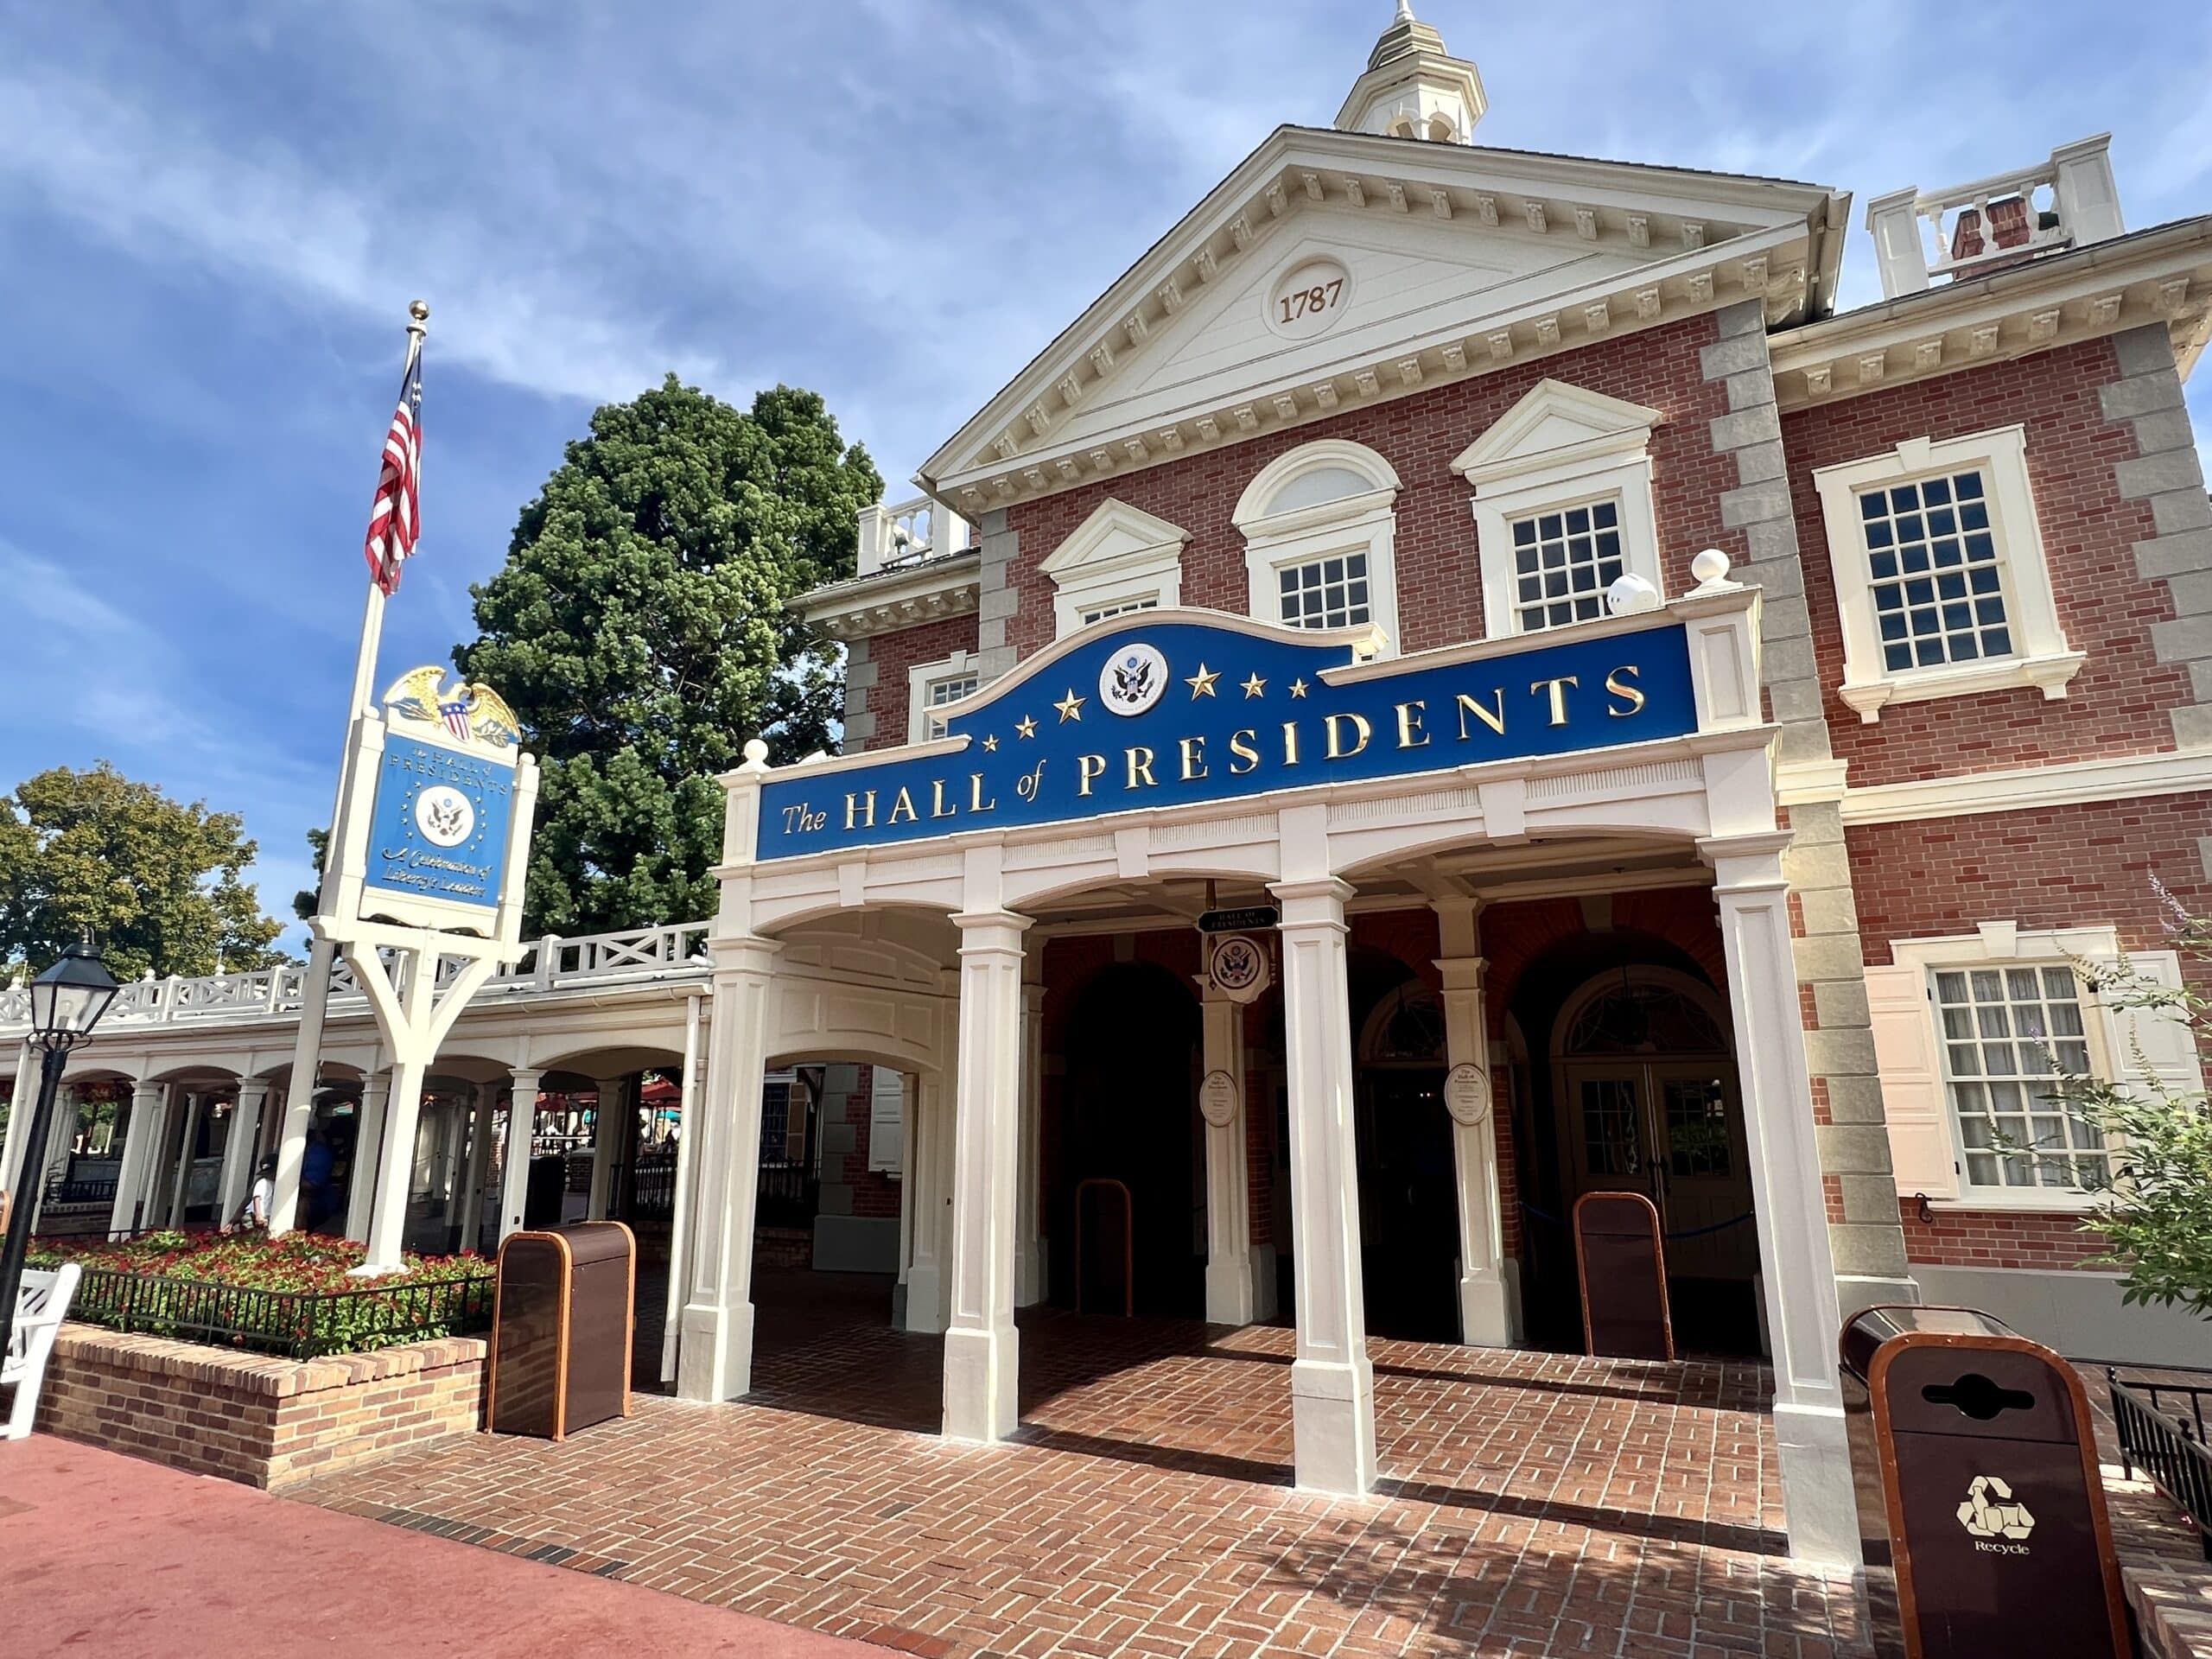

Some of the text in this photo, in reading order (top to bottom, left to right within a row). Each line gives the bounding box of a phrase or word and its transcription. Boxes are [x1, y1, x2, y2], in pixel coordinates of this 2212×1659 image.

[1280, 277, 1344, 324] 1787
[431, 752, 479, 773] HALL
[782, 802, 827, 836] The
[842, 772, 996, 830] HALL
[1016, 759, 1047, 804] of
[1077, 664, 1646, 798] PRESIDENTS
[388, 753, 509, 796] PRESIDENTS
[1974, 1540, 2031, 1555] Recycle
